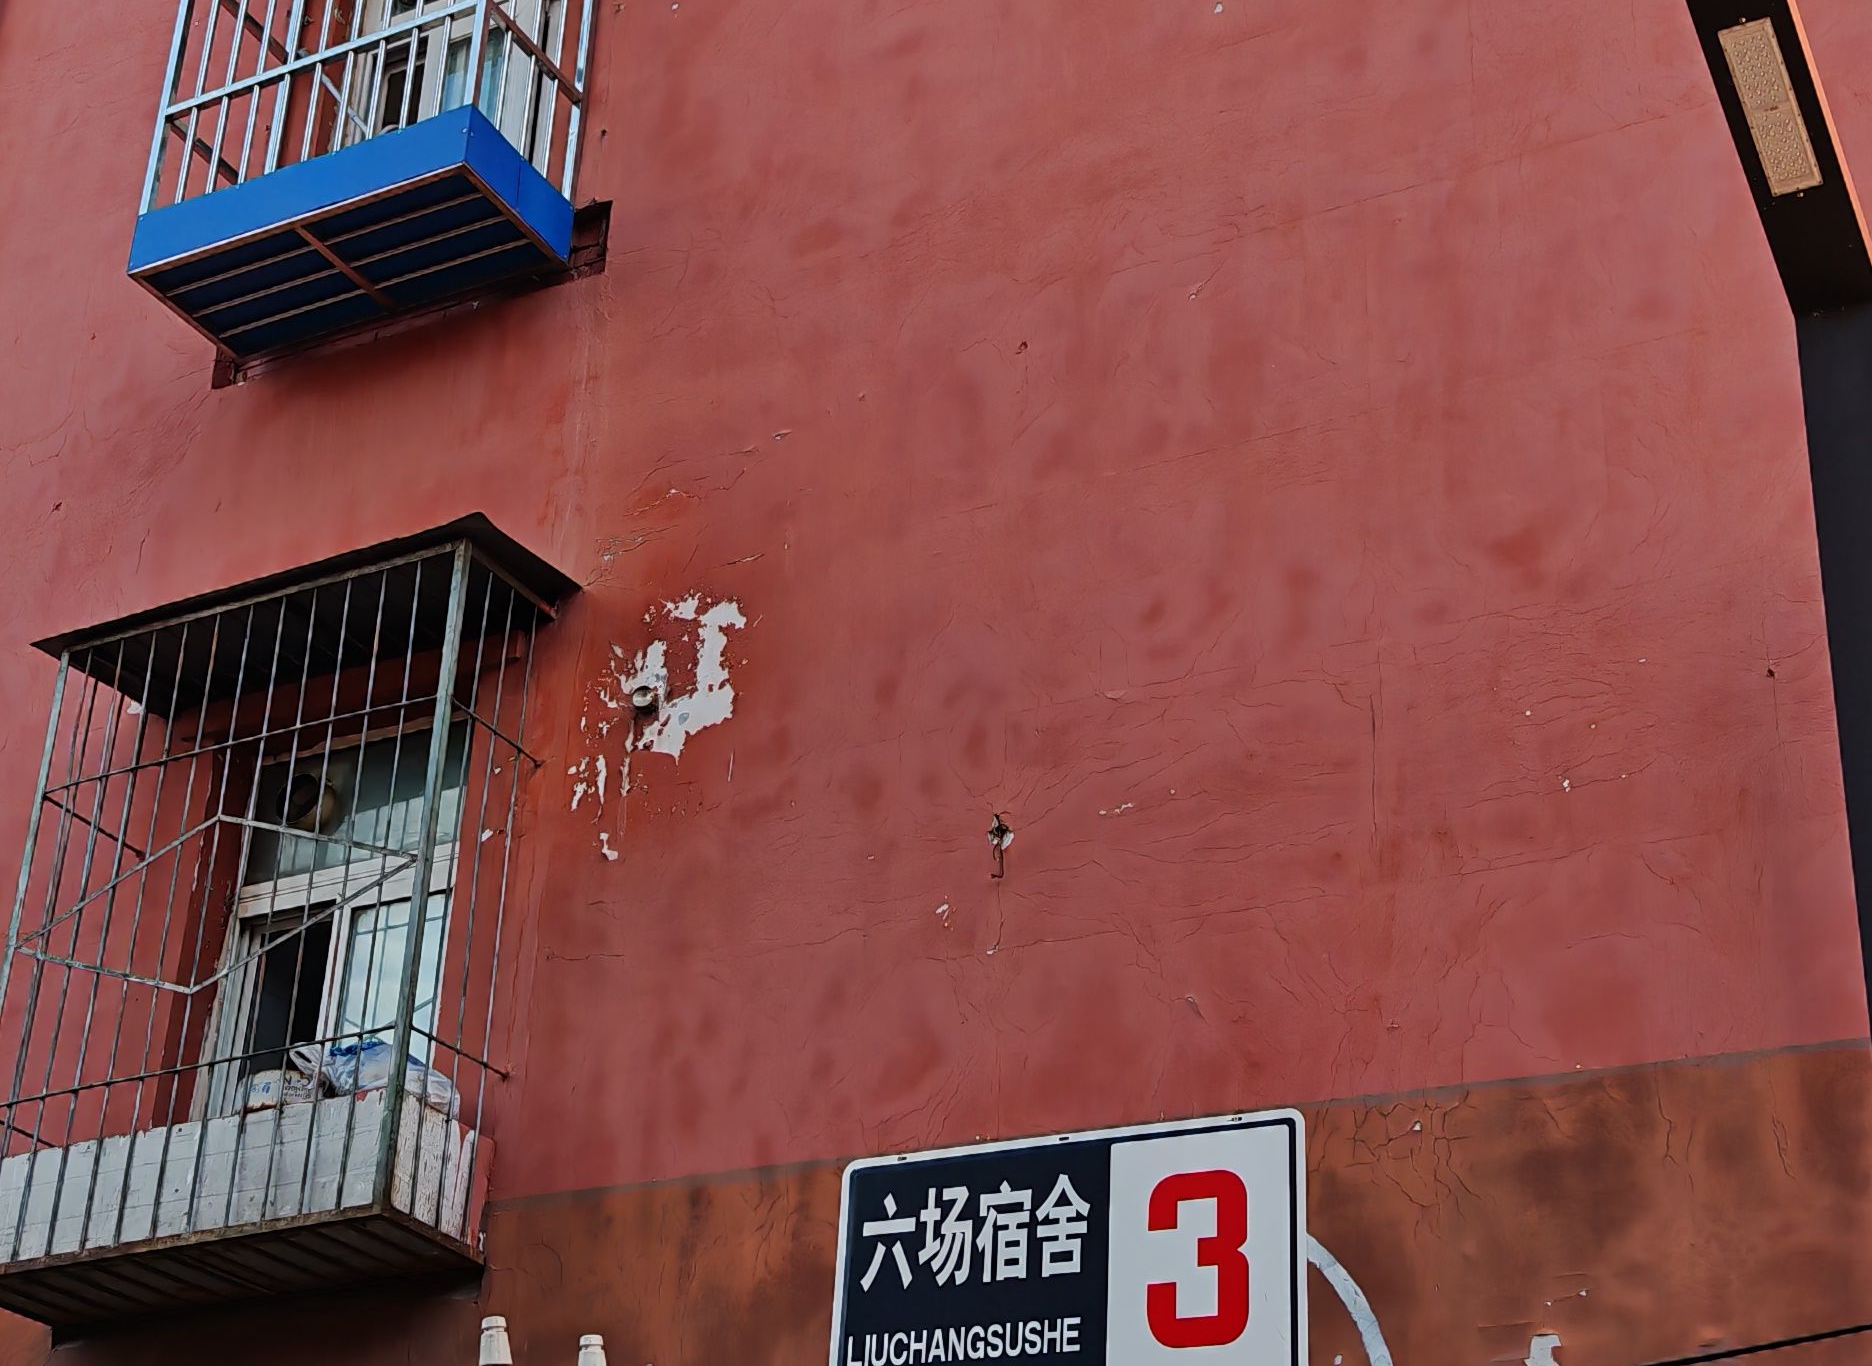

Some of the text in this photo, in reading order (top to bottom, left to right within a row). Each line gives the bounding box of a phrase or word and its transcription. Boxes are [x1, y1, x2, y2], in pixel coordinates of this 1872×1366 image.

[860, 1172, 1092, 1293] 六场宿舍
[1146, 1168, 1250, 1349] 3
